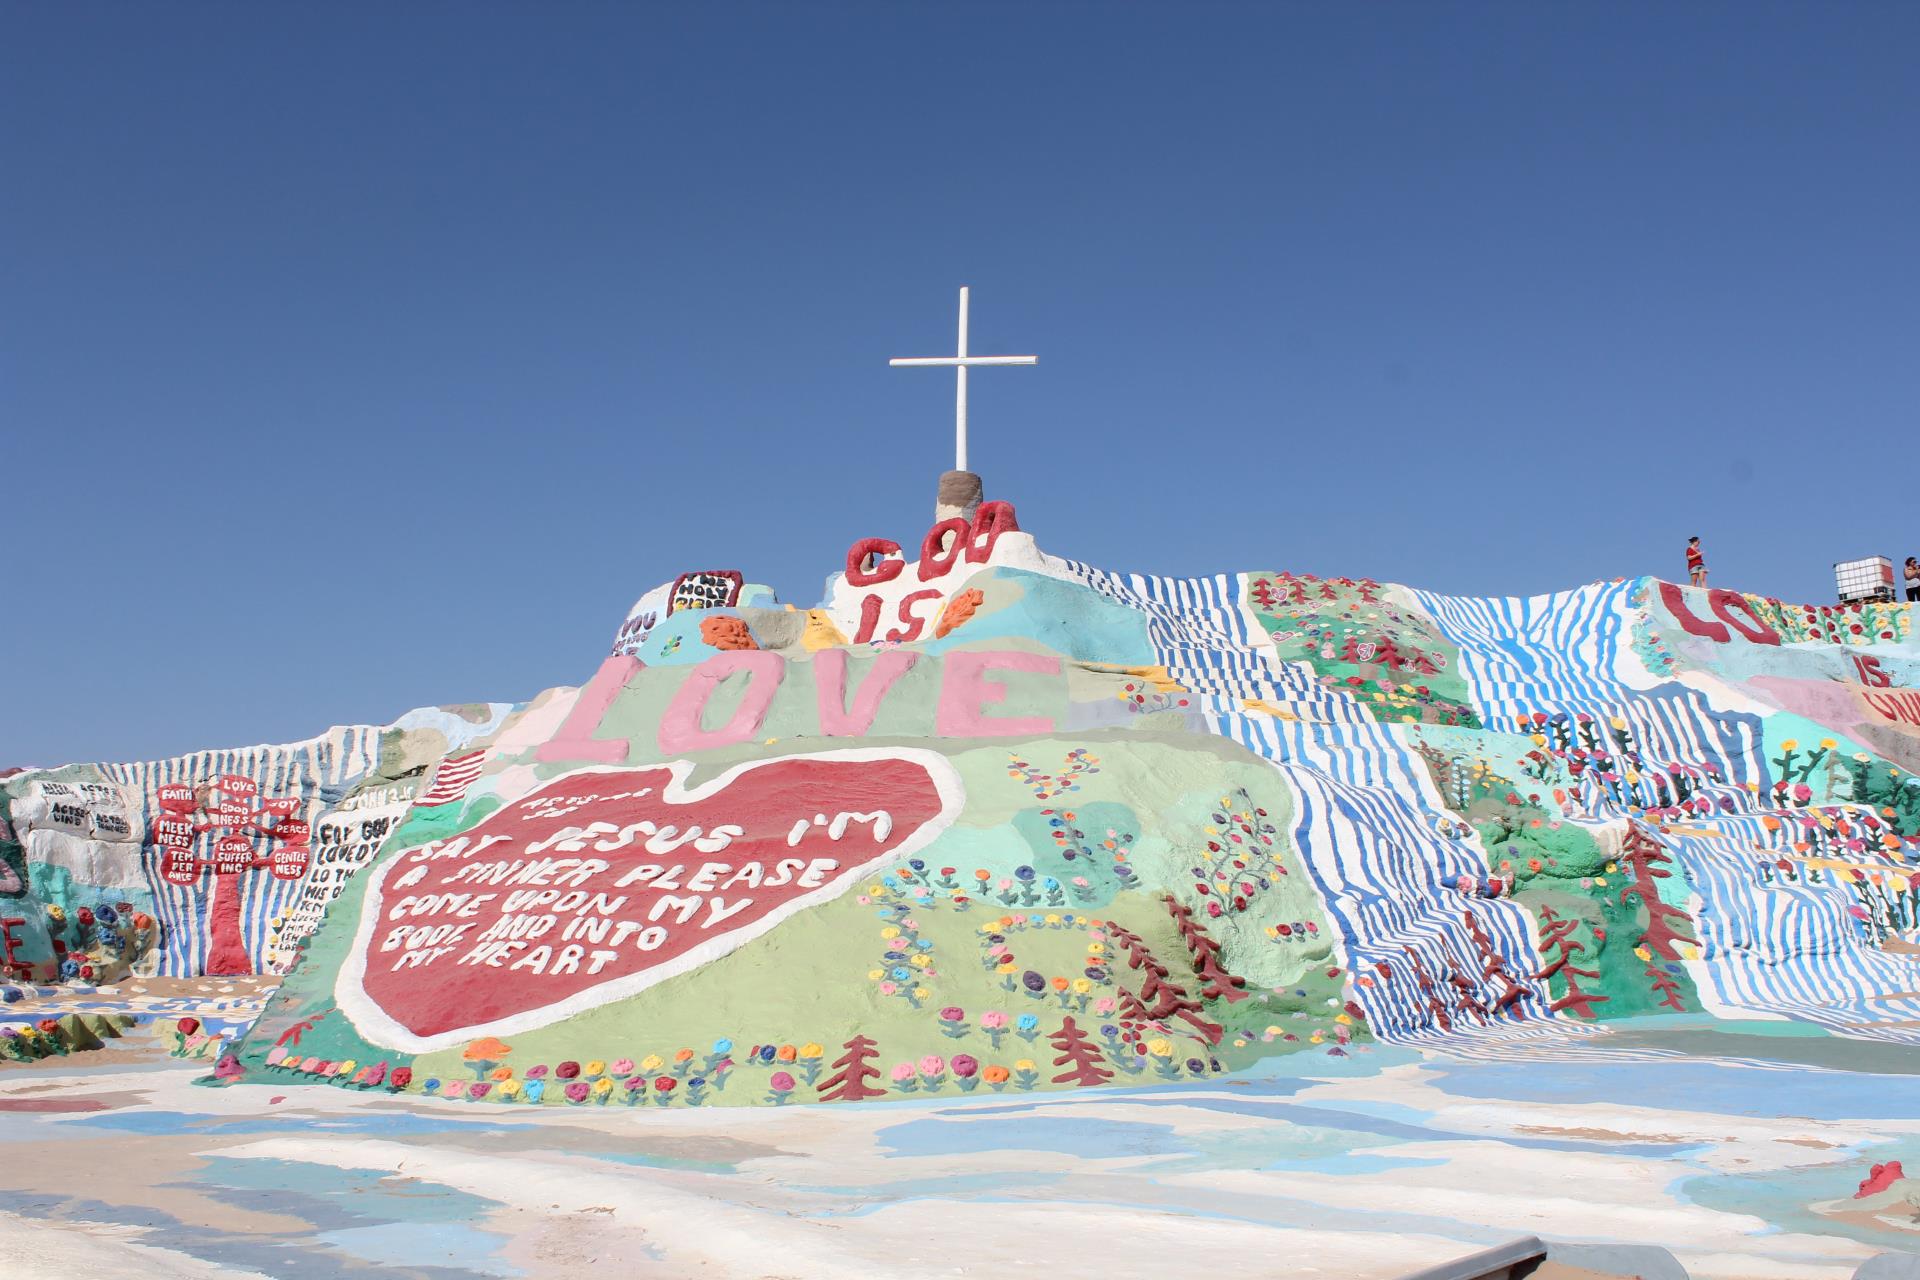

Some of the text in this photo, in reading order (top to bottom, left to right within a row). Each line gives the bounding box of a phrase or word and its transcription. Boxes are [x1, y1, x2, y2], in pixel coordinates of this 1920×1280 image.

[846, 501, 1020, 586] GOD
[679, 583, 729, 599] HOLY
[621, 611, 656, 638] YOU
[854, 589, 944, 644] IS
[1852, 655, 1891, 688] IS
[535, 648, 1062, 764] LOVE
[1862, 691, 1920, 726] UNI
[223, 779, 255, 793] LOVE
[162, 788, 193, 801] FAITH
[220, 803, 249, 815] GOOD
[269, 800, 297, 811] JOY
[159, 820, 193, 836] MEEK
[220, 815, 249, 826] NESS
[361, 816, 390, 841] GOD
[276, 825, 308, 834] PEACE
[409, 809, 893, 862] SAY JESUS I'M
[158, 833, 189, 847] NESS
[171, 851, 194, 862] TEM
[217, 852, 253, 863] SUFFER
[274, 852, 307, 864] GENTLE
[172, 862, 193, 871] PER
[275, 865, 303, 876] NESS
[392, 857, 841, 892] A SINNER PLEASE
[389, 888, 754, 929] COME UPON MY
[379, 913, 669, 953] BODY AND INTO
[390, 939, 620, 975] MY HEART
